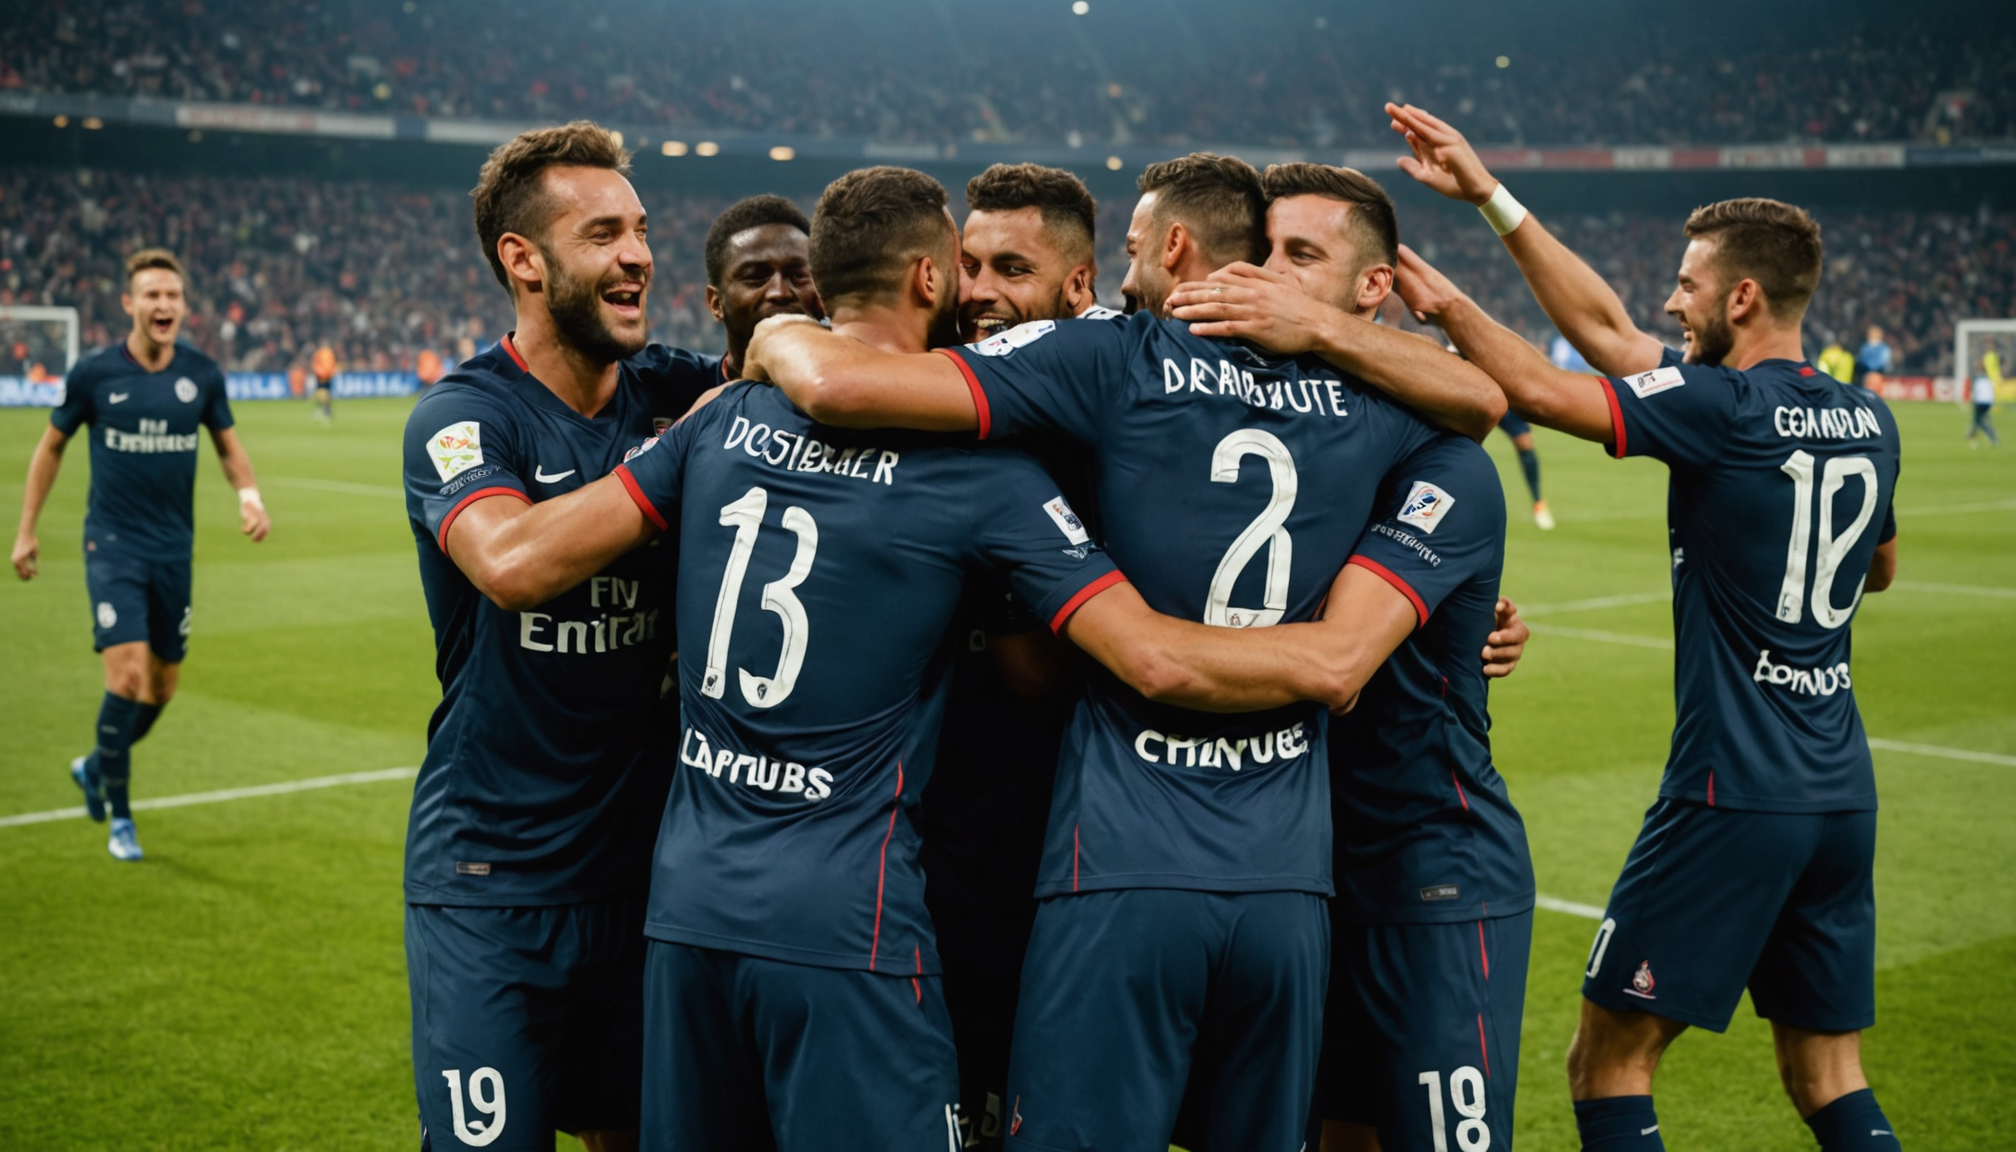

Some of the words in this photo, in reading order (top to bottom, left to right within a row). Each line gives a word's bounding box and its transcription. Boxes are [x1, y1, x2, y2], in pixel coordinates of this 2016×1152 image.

[701, 486, 819, 709] 13
[442, 1066, 506, 1147] 19
[1418, 1065, 1491, 1152] 18
